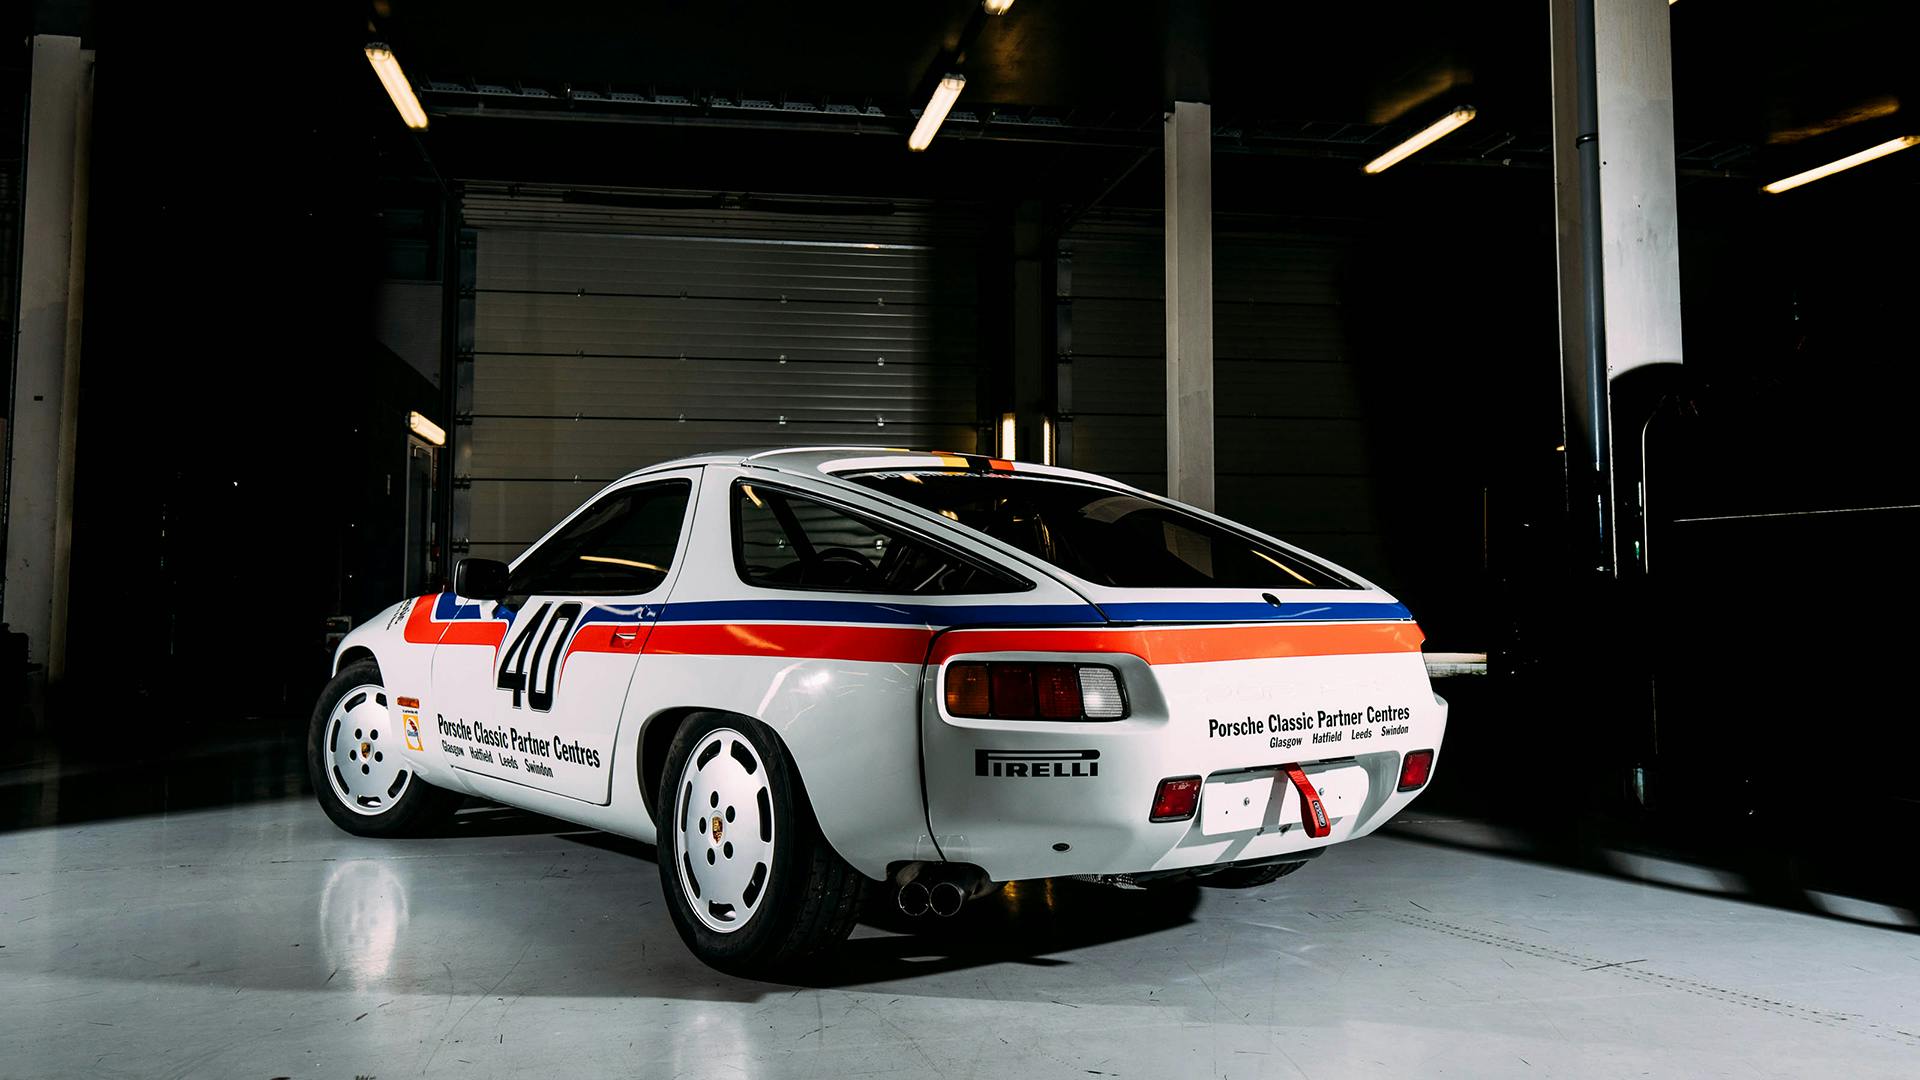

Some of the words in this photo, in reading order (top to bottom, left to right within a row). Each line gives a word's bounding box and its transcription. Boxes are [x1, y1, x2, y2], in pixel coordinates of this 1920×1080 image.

[497, 601, 583, 713] 40
[1208, 716, 1264, 738] Porsche
[1268, 711, 1314, 733] Classic
[1317, 709, 1363, 729] Partner
[1366, 704, 1410, 723] Centres
[1269, 736, 1303, 749] Glasgow
[1312, 731, 1342, 744] Hatfield
[1351, 728, 1372, 740] Leeds
[1381, 725, 1409, 737] Swindon
[437, 713, 472, 741] Porsche
[474, 720, 509, 749] Classic
[510, 727, 550, 757] Partner
[553, 735, 600, 768] Centres
[441, 739, 465, 757] Glasgow
[469, 746, 494, 763] Hatfield
[498, 752, 519, 770] Leeds
[524, 758, 554, 778] Swindon
[975, 749, 1101, 777] PIRELLI
